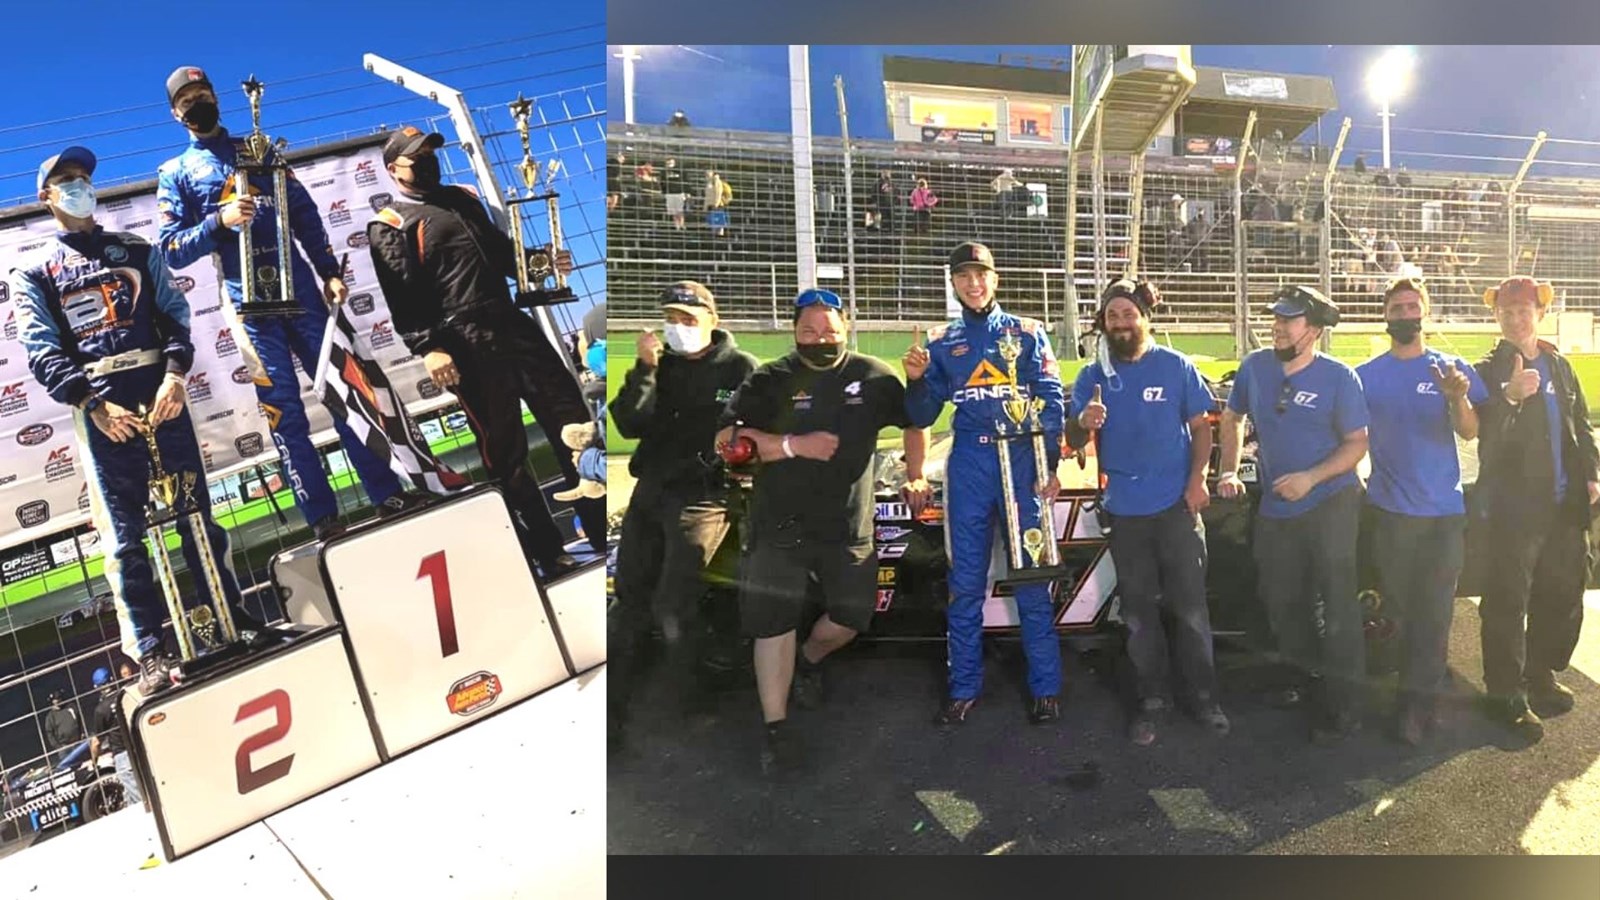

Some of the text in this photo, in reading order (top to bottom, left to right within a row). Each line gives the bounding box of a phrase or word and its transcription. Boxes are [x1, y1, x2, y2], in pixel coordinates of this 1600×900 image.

[844, 381, 861, 395] 4
[1143, 386, 1164, 401] 67
[1416, 382, 1434, 393] 67
[1293, 390, 1318, 406] 67
[273, 432, 309, 504] CANAC
[415, 550, 459, 658] 1
[233, 688, 295, 795] 2
[40, 805, 69, 825] elite
